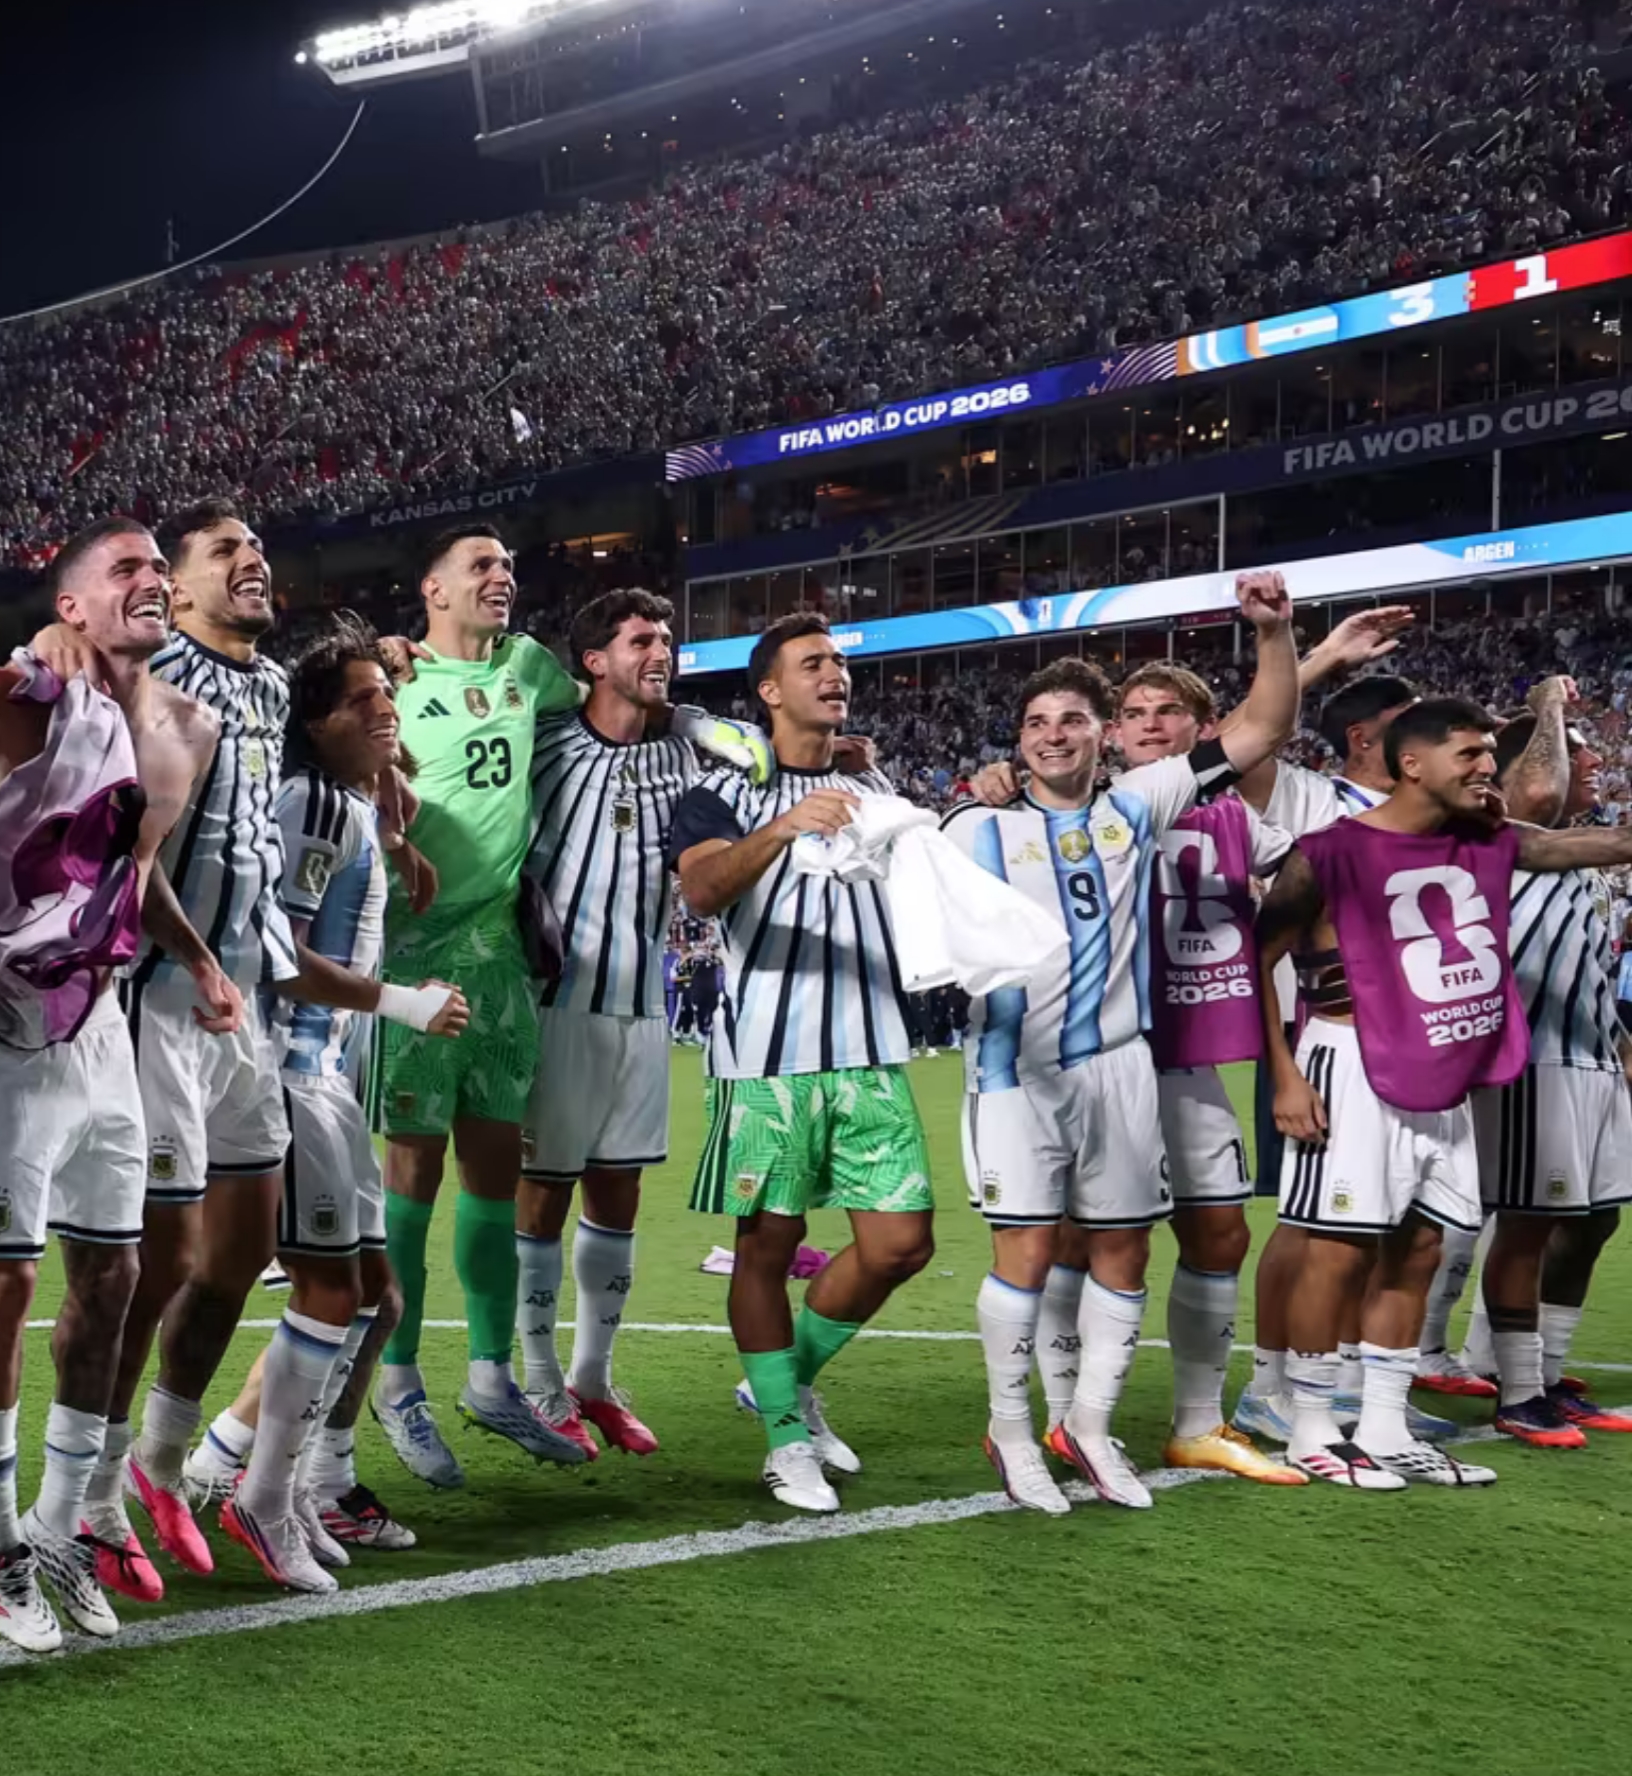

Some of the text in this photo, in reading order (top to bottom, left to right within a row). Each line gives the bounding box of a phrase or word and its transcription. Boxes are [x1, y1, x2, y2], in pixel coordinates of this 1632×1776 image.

[1388, 255, 1558, 326] 3 1
[779, 428, 823, 453] FIFA
[904, 401, 948, 426] CUP
[950, 382, 1031, 417] 2026
[1284, 439, 1356, 474] FIFA
[1362, 414, 1494, 460] WORLD
[1501, 396, 1579, 434] CUP
[370, 481, 537, 527] KANSAS CITY
[465, 736, 511, 789] 23
[1068, 871, 1101, 921] 9
[1178, 938, 1217, 954] FIFA
[1165, 978, 1254, 1005] 2026
[1214, 963, 1249, 979] CUP
[1440, 966, 1485, 989] FIFA
[1419, 1002, 1482, 1025] WORLD
